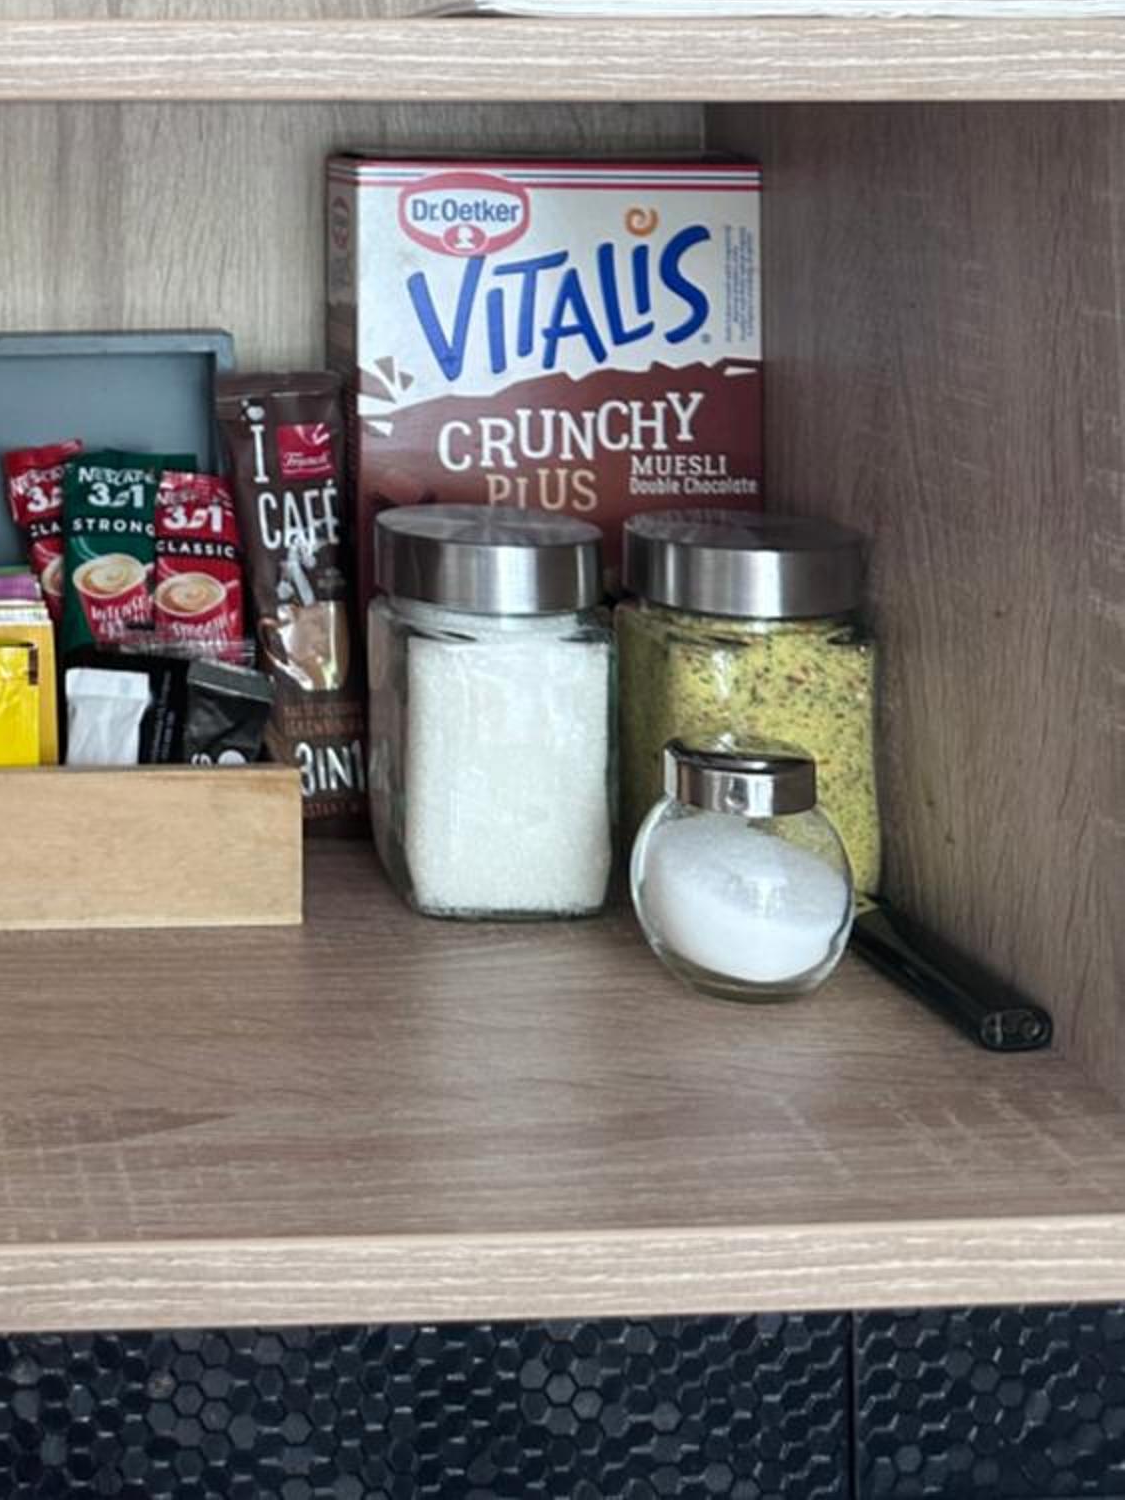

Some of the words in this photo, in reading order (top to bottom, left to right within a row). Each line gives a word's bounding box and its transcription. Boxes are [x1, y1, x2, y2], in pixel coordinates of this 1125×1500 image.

[437, 392, 704, 472] CRUNCHY
[630, 454, 727, 476] MUESLI
[629, 477, 680, 495] Double
[682, 477, 759, 496] Chocolate
[155, 540, 237, 559] CLASSIC
